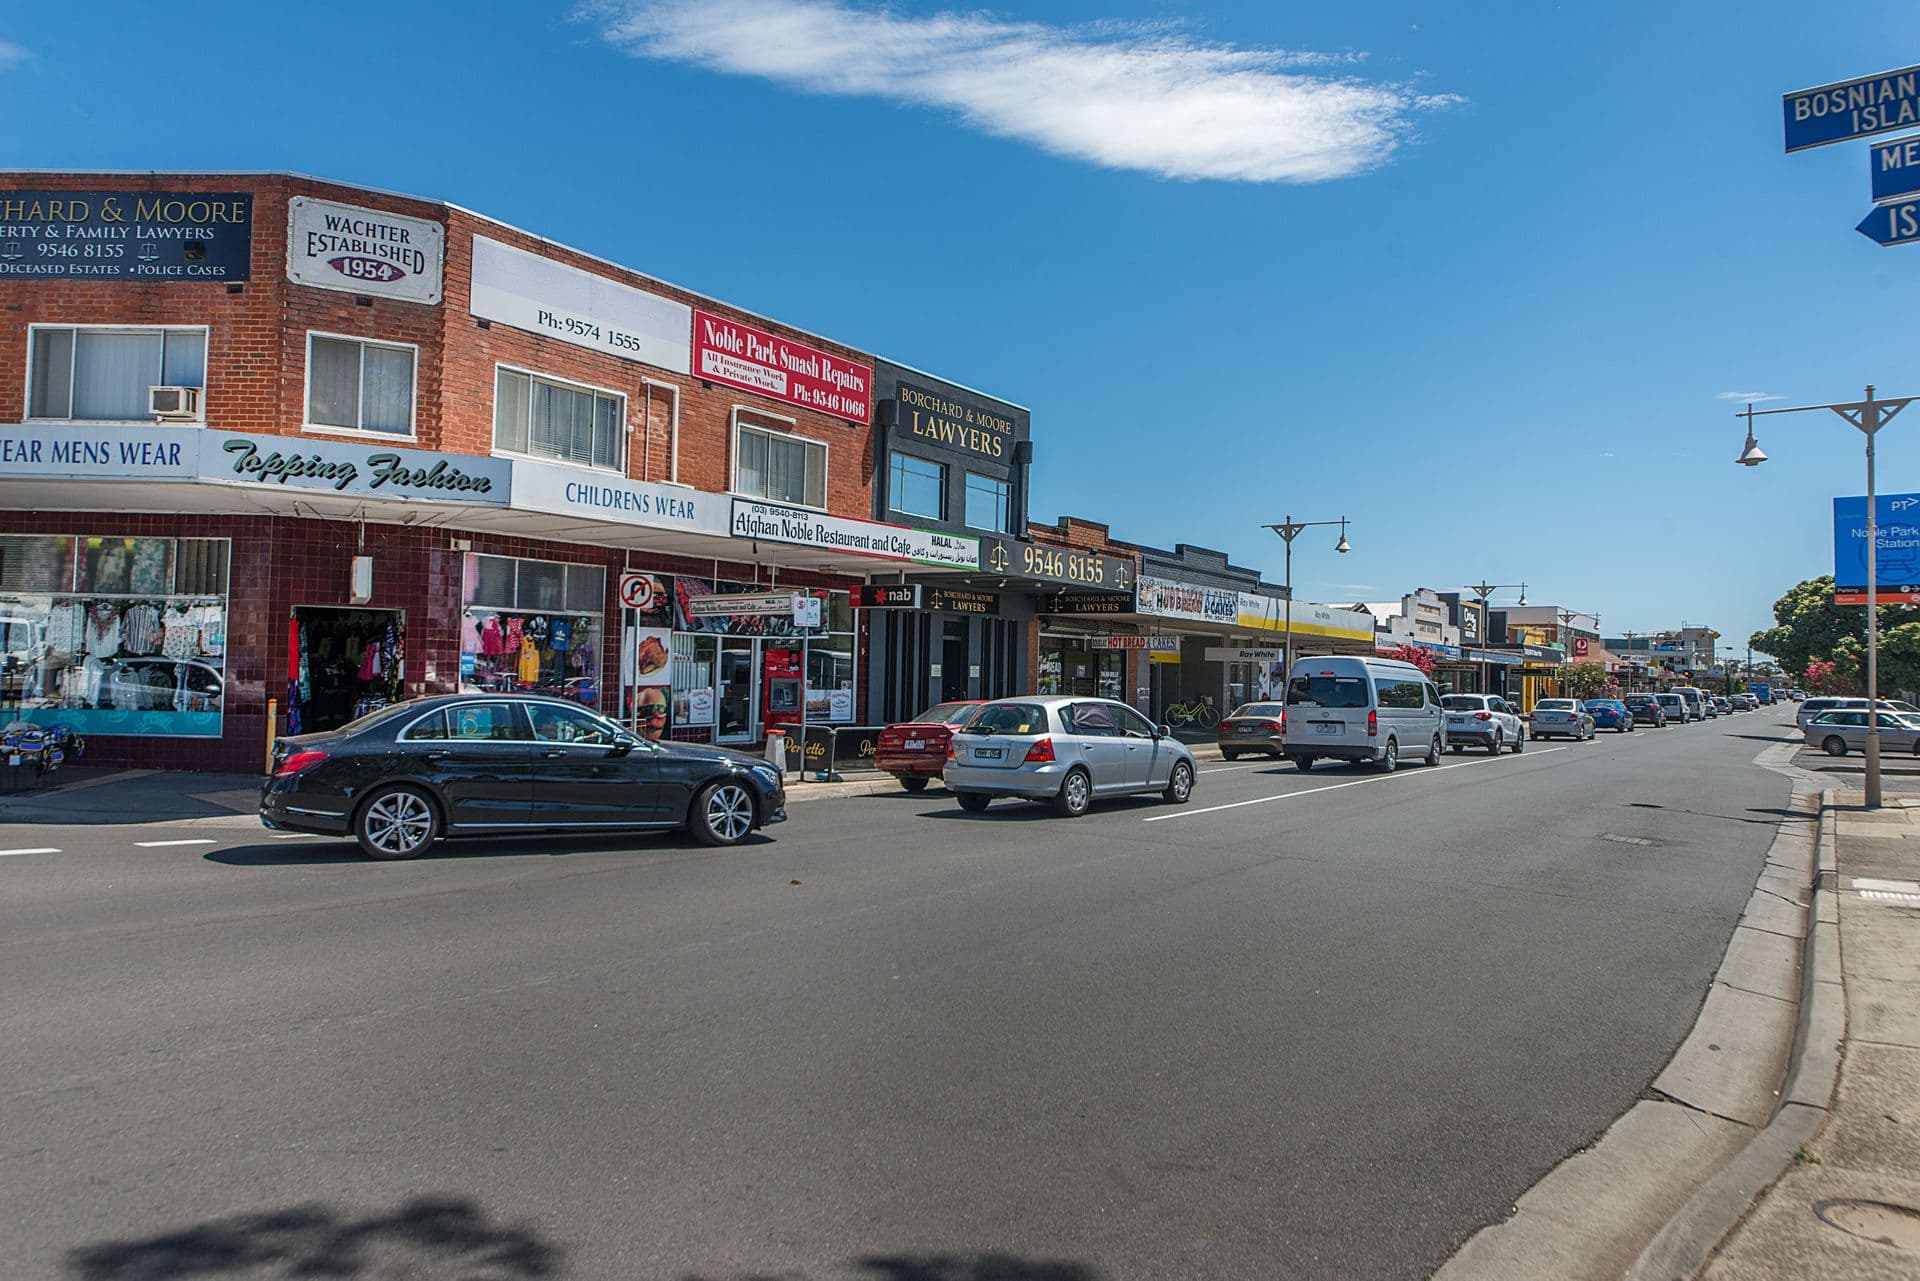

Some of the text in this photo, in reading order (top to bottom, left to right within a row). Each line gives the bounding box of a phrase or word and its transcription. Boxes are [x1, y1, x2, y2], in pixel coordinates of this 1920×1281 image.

[1794, 73, 1916, 121] BOSNIAN
[1852, 97, 1920, 132] ISLA
[0, 197, 245, 223] HARD & MOORE
[45, 224, 60, 238] &
[66, 225, 129, 239] FAMILY
[136, 226, 215, 240] LAWYERS
[324, 214, 410, 244] WACHTER
[37, 243, 124, 258] 9546 8155
[307, 231, 425, 274] ESTABLISHED
[0, 263, 64, 274] DECEASED
[69, 264, 120, 275] ESTATES
[187, 265, 226, 276] CASES
[342, 257, 393, 281] 1954
[537, 309, 641, 352] Ph: 9574 1555
[703, 319, 864, 393] Noble Park Smash Repairs
[705, 352, 784, 382] All Insurance Work
[712, 364, 778, 390] & Private Work.
[793, 382, 865, 418] Ph: 9546 1066
[902, 387, 1012, 435] BORCHARD & MOORE
[912, 411, 1002, 457] LAWYERS
[0, 439, 181, 466] EAR MENS WEAR
[223, 438, 492, 494] Topping Fashion
[566, 482, 694, 520] CHILDRENS WEAR
[751, 505, 809, 521] (03) 9540-8113
[736, 512, 911, 556] Afghan Noble Restaurant and Cafe
[931, 535, 952, 549] HALAL
[1876, 539, 1920, 549] Station
[1891, 526, 1920, 537] Park
[1024, 546, 1103, 584] 9546 8155
[888, 588, 912, 601] nab
[952, 601, 986, 612] LAWYERS
[1075, 603, 1120, 612] LAWYERS
[1108, 637, 1122, 648] HOT
[1124, 637, 1146, 648] BREAD
[1153, 637, 1176, 649] CAKES
[1240, 650, 1275, 659] Ray White
